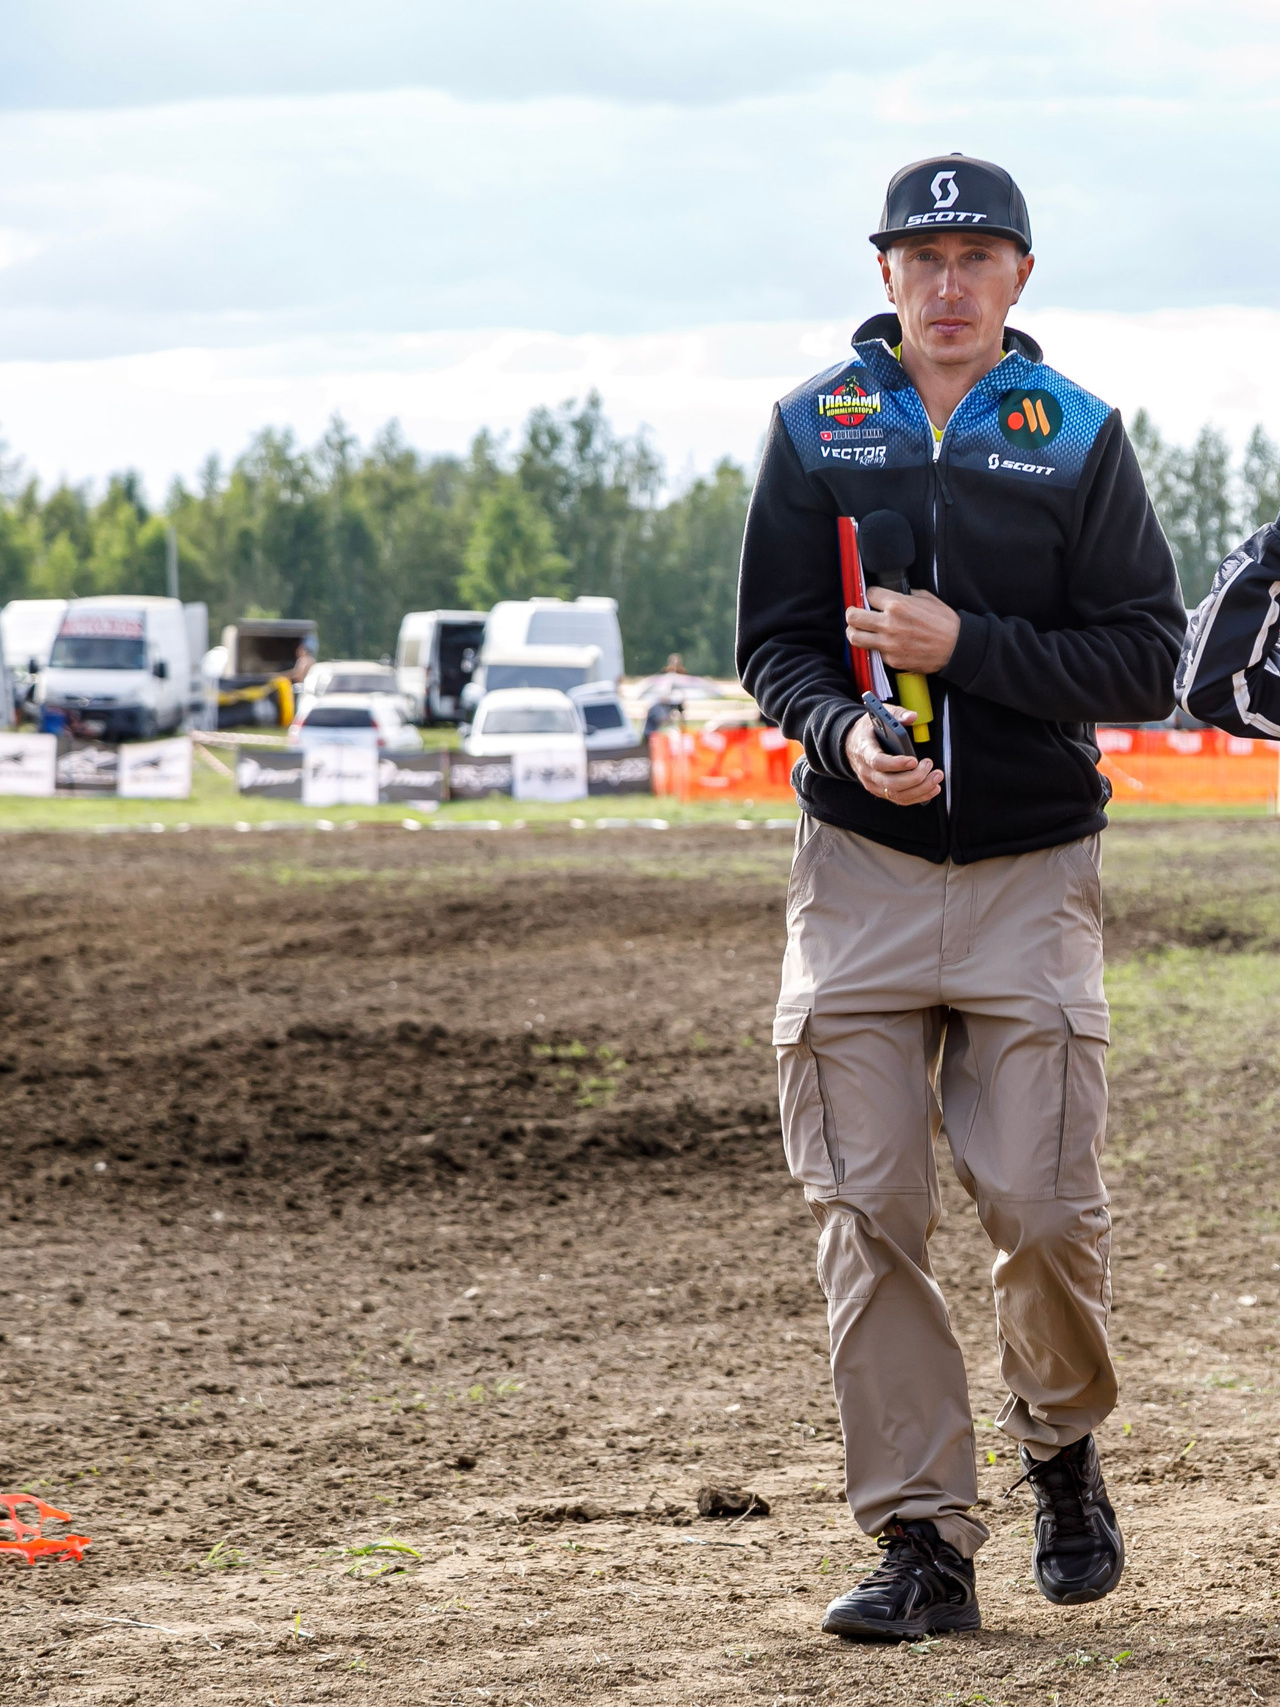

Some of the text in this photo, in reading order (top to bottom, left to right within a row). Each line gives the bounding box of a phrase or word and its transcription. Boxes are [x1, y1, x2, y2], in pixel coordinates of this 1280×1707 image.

[905, 211, 987, 227] SCOTT
[820, 445, 886, 461] VECTOR
[1000, 459, 1055, 475] SCOTT
